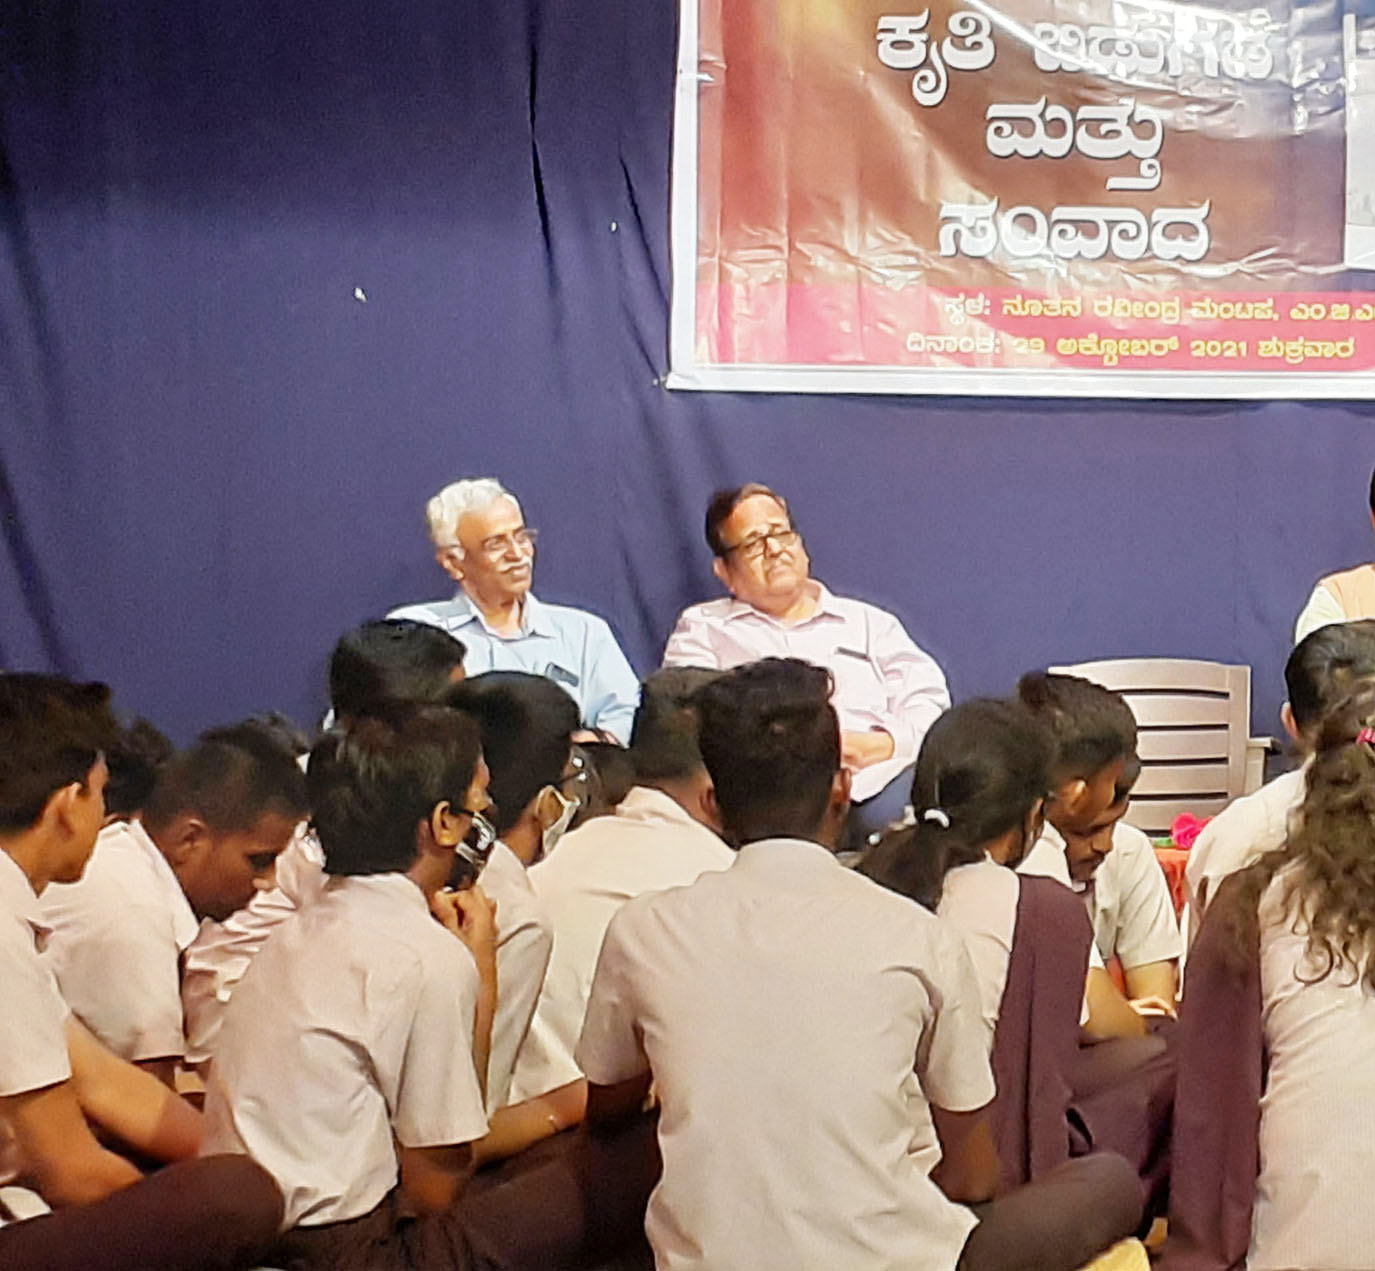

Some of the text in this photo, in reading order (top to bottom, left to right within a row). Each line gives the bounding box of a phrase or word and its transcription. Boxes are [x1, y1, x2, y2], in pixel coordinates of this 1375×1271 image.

[875, 7, 996, 107] ಕೃತಿ
[985, 96, 1164, 191] ಮತ್ತು
[938, 196, 1212, 262] ಸಂವಾದ
[1002, 293, 1082, 317] ನೂತನ
[1093, 295, 1180, 325] ರವೀಂದ್ರ
[1012, 337, 1046, 354] 29
[1190, 340, 1248, 358] 2021
[1258, 336, 1354, 364] ಶುಕ್ರವಾರ
